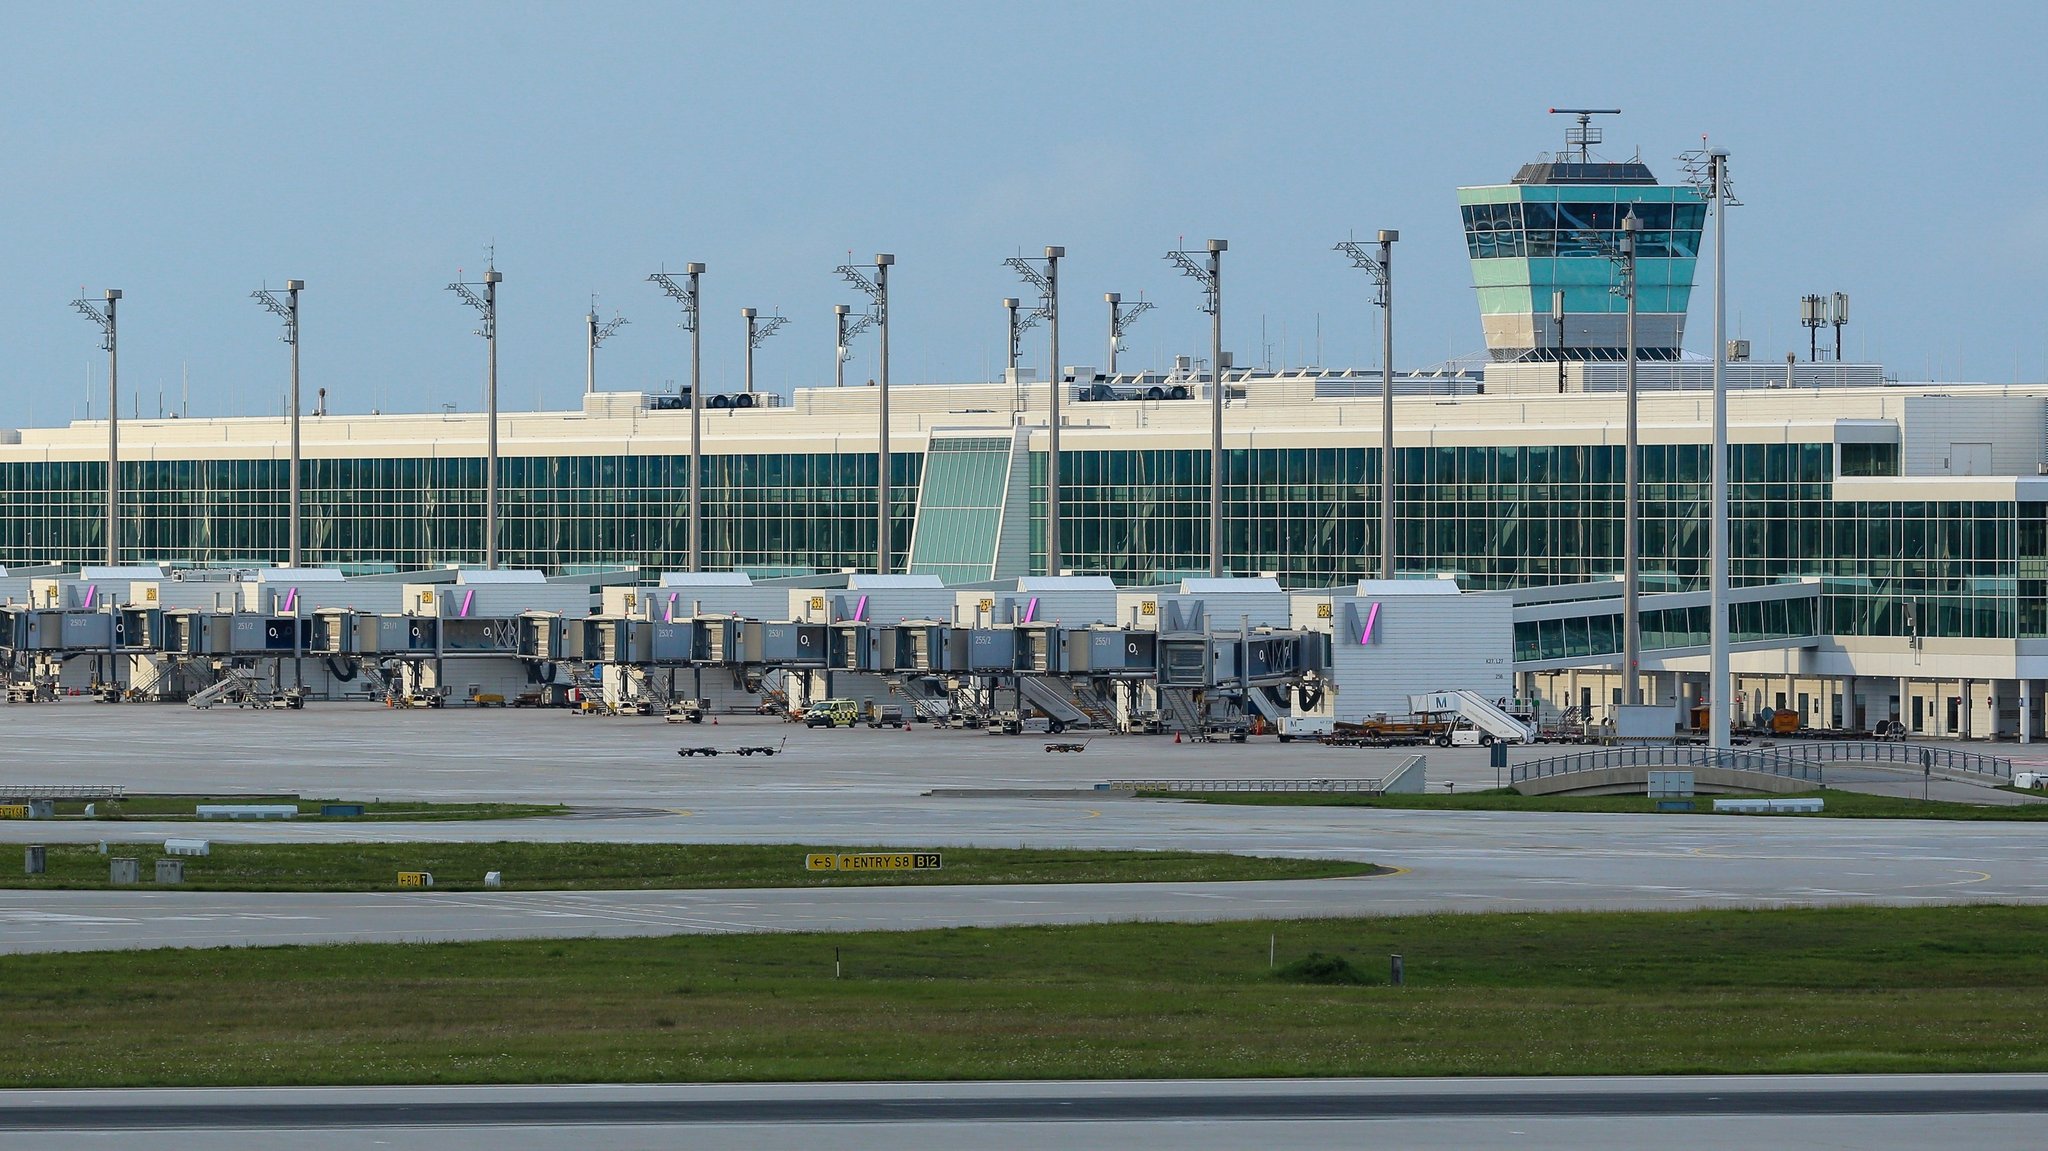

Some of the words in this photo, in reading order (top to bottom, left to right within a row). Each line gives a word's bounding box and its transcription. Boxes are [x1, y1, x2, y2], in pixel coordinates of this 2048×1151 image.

[811, 597, 823, 610] 253
[1142, 602, 1155, 615] 255
[1167, 599, 1205, 630] M
[1318, 604, 1331, 618] 256
[237, 622, 254, 630] 251/2
[1344, 601, 1382, 646] M
[768, 629, 784, 638] 253/1
[975, 635, 992, 645] 255/2
[1095, 636, 1111, 646] 255/1
[1435, 696, 1448, 709] M
[1290, 720, 1297, 728] M
[824, 856, 832, 868] S
[853, 856, 891, 868] ENTRY
[894, 856, 910, 867] S8
[917, 855, 938, 868] B12
[407, 875, 419, 887] B12
